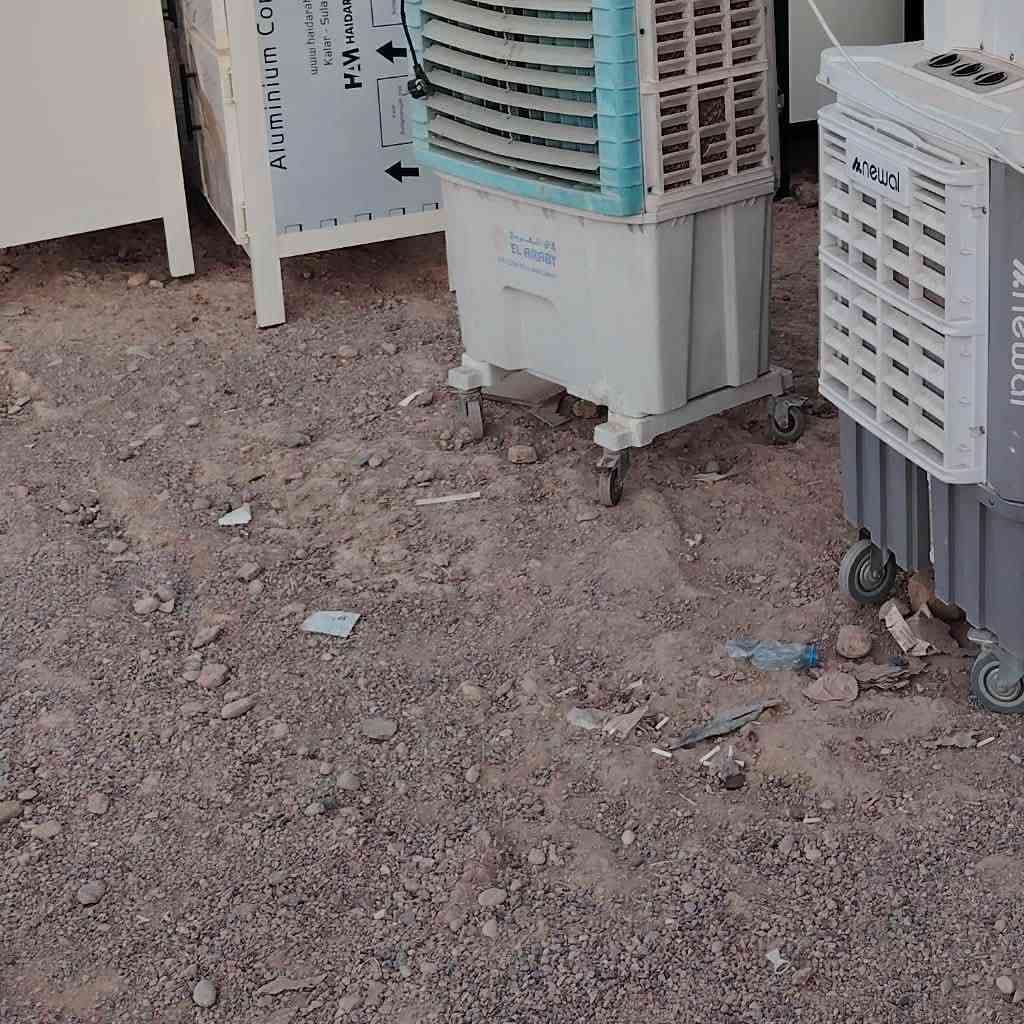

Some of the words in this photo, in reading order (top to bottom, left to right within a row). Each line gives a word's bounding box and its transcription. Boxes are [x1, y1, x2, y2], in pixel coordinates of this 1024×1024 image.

[322, 39, 333, 66] Kalar
[262, 46, 287, 170] Aluminium
[862, 160, 900, 193] newal
